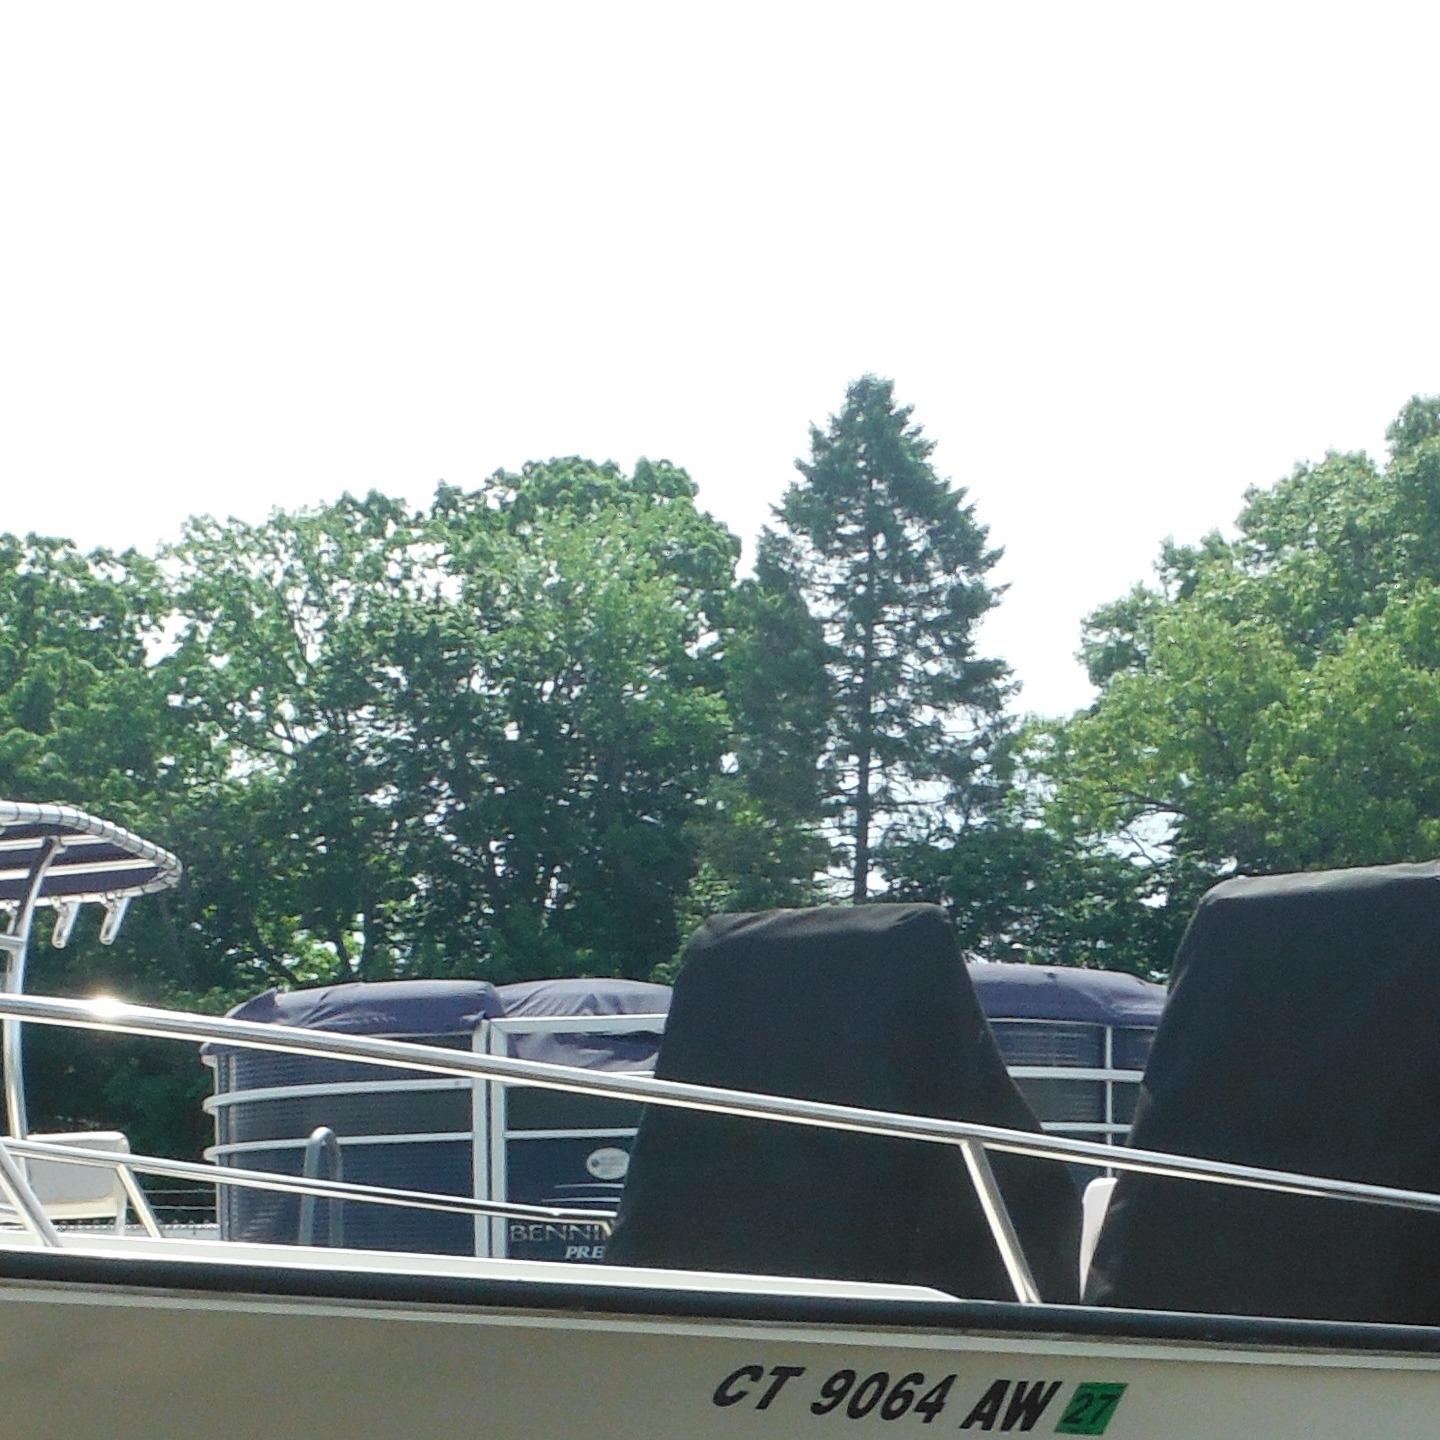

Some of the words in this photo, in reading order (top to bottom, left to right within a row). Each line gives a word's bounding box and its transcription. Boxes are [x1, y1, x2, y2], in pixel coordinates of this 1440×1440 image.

[711, 1364, 807, 1411] CT
[808, 1368, 958, 1425] 9064
[959, 1378, 1064, 1433] AW
[1062, 1392, 1121, 1425] 27
